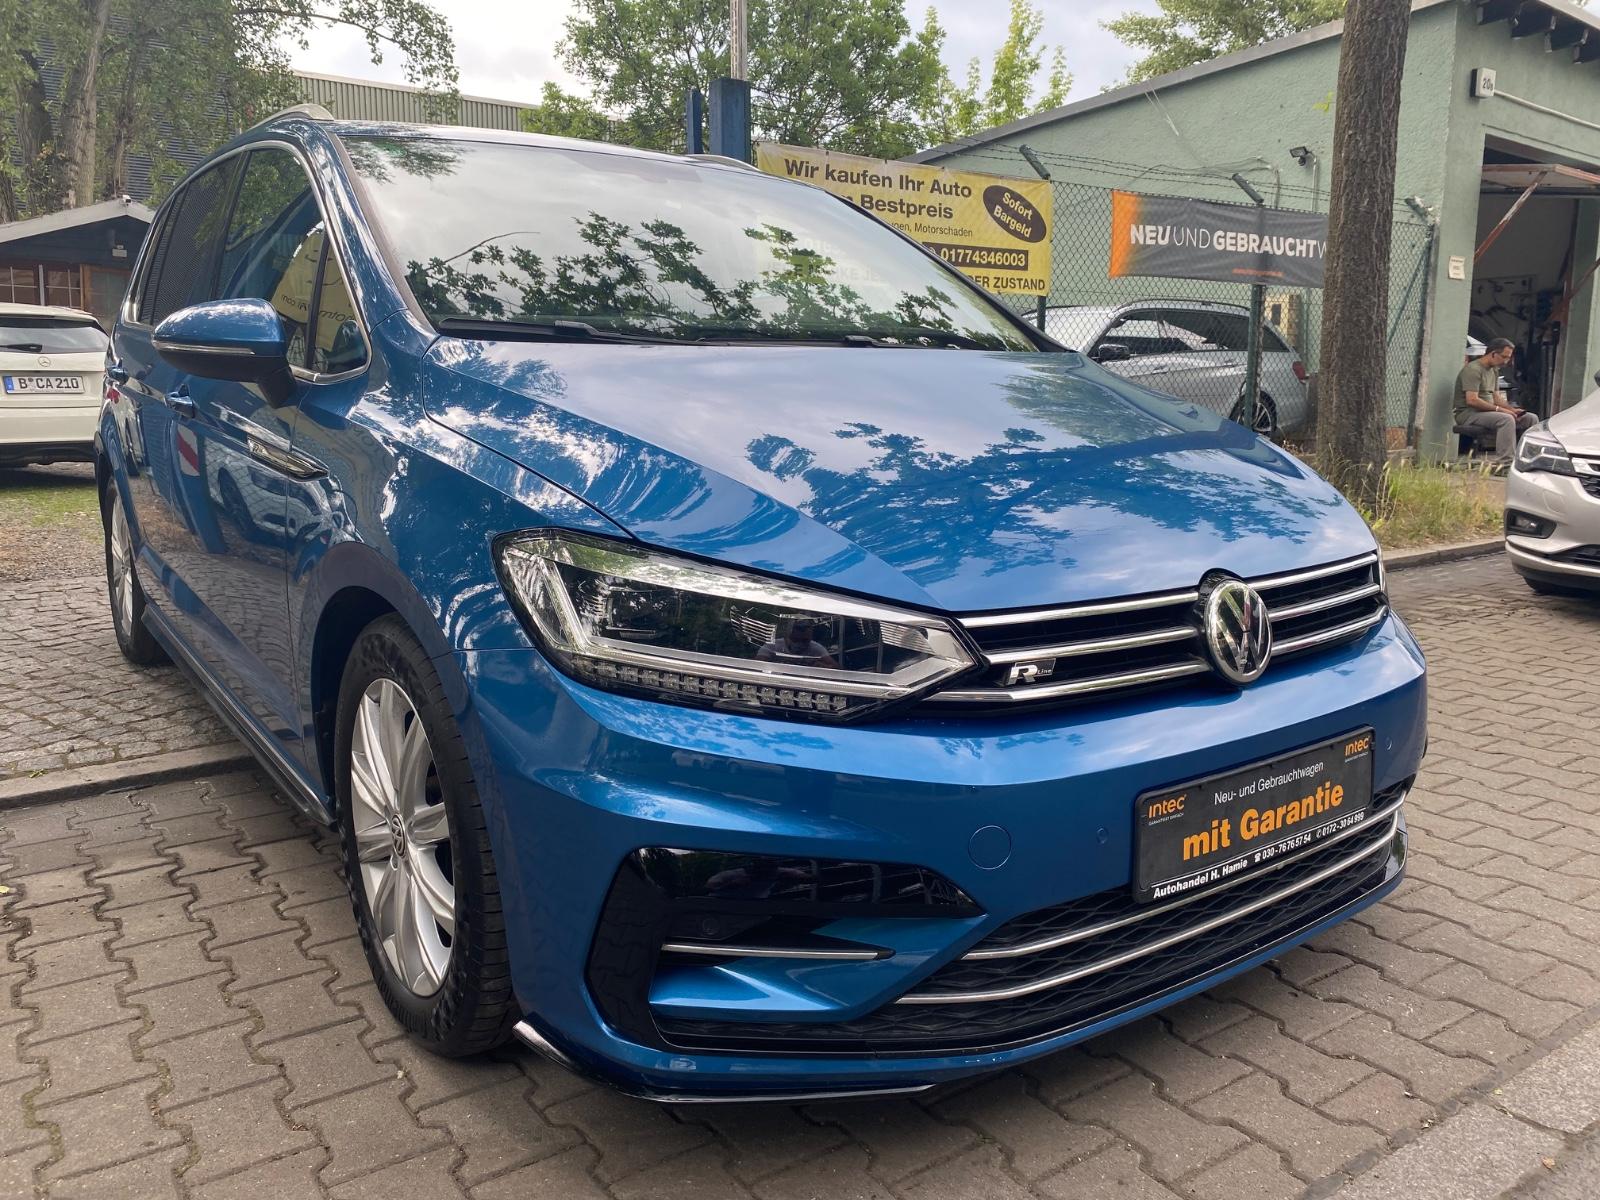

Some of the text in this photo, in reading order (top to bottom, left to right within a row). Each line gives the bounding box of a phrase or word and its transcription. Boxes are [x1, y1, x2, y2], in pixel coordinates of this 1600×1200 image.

[784, 158, 972, 198] Wir kaufen Ihr Auto
[860, 194, 954, 219] Bestpreis
[1002, 192, 1033, 220] Sofort
[914, 222, 973, 238] Motorschaden
[993, 204, 1032, 238] Bargeld
[1130, 224, 1171, 246] NEU
[1173, 228, 1212, 249] UND
[940, 247, 1026, 267] 01774346003
[993, 276, 1046, 291] ZUSTAND
[18, 378, 28, 389] B
[55, 377, 79, 389] 210
[1214, 761, 1325, 806] Neu- und Gebrauchtwagen
[1182, 780, 1345, 862] mit Garantie
[1153, 872, 1209, 899] Autohandel
[1210, 869, 1221, 881] H.
[1222, 858, 1248, 877] Hamie
